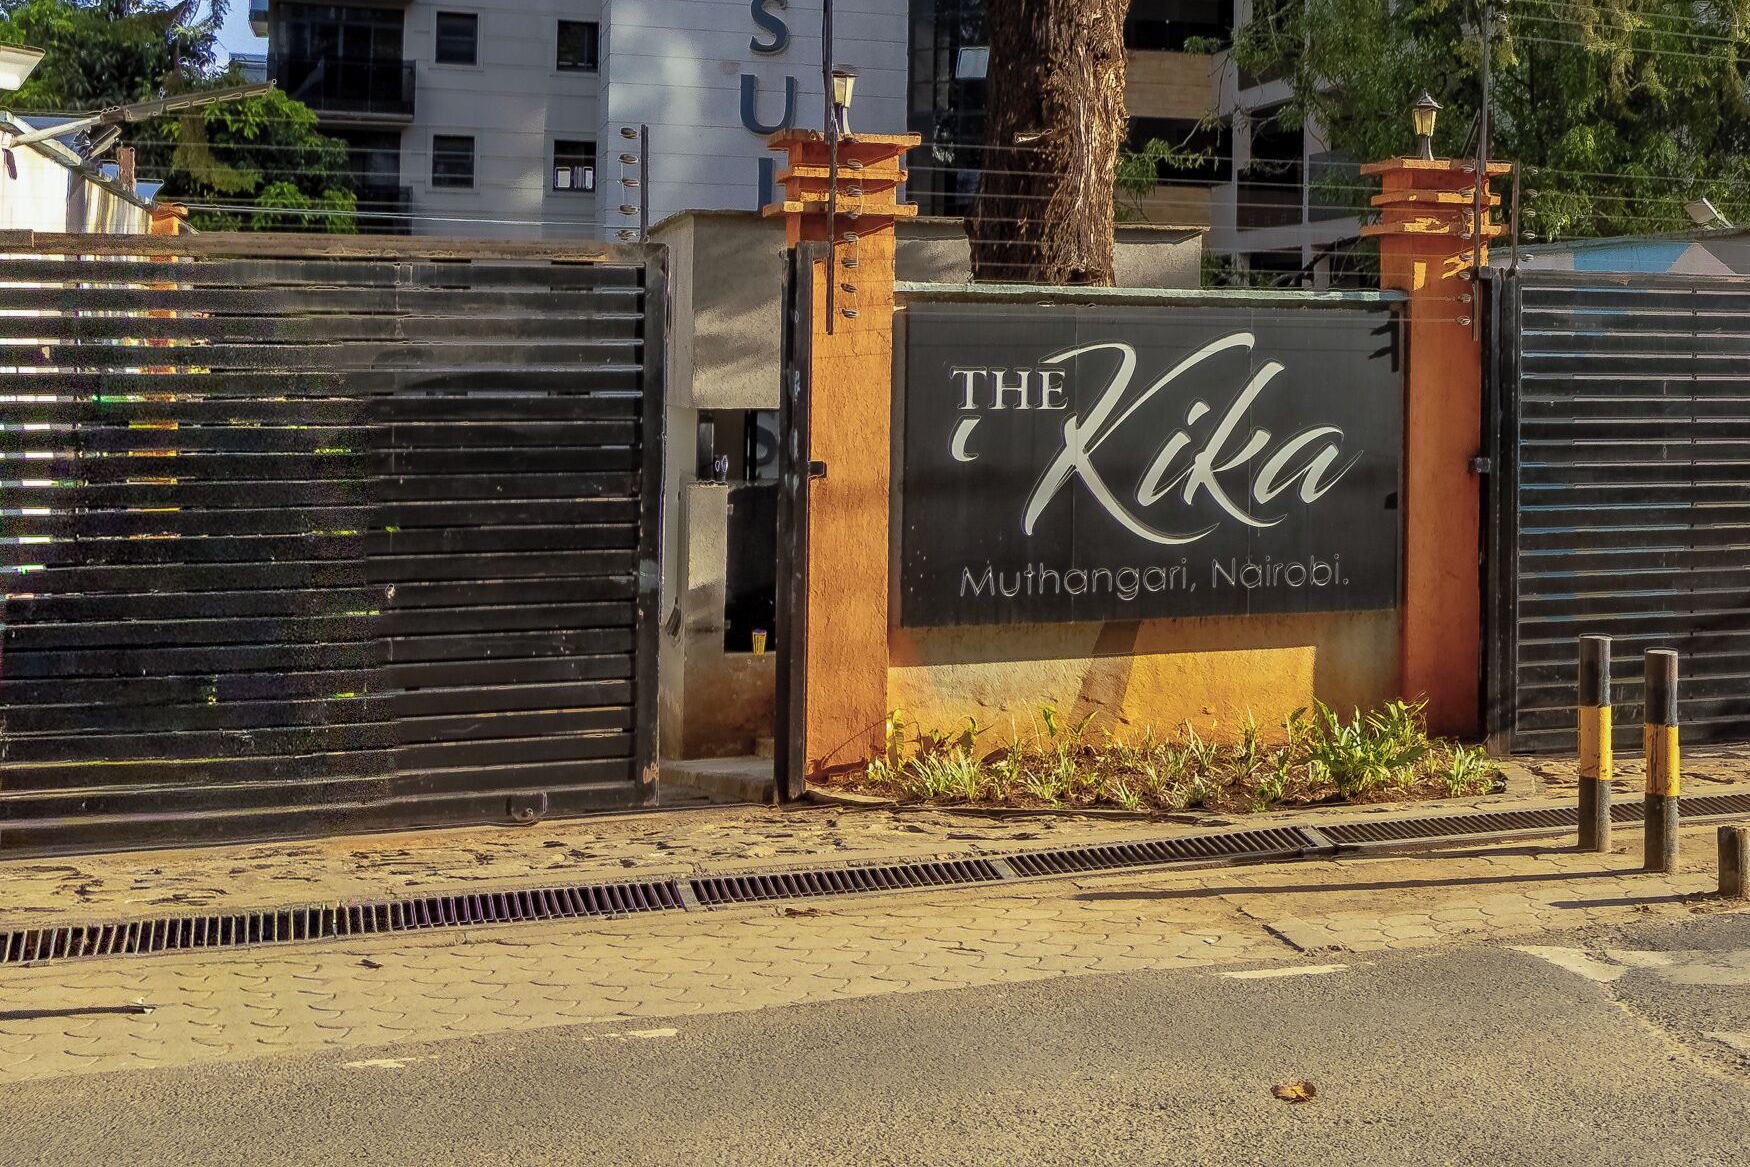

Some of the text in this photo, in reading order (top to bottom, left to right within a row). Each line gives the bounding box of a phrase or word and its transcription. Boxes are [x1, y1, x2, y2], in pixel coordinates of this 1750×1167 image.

[949, 366, 1068, 411] THE
[1022, 328, 1364, 545] Kika
[960, 555, 1350, 601] Muthangari, Nairobi.
